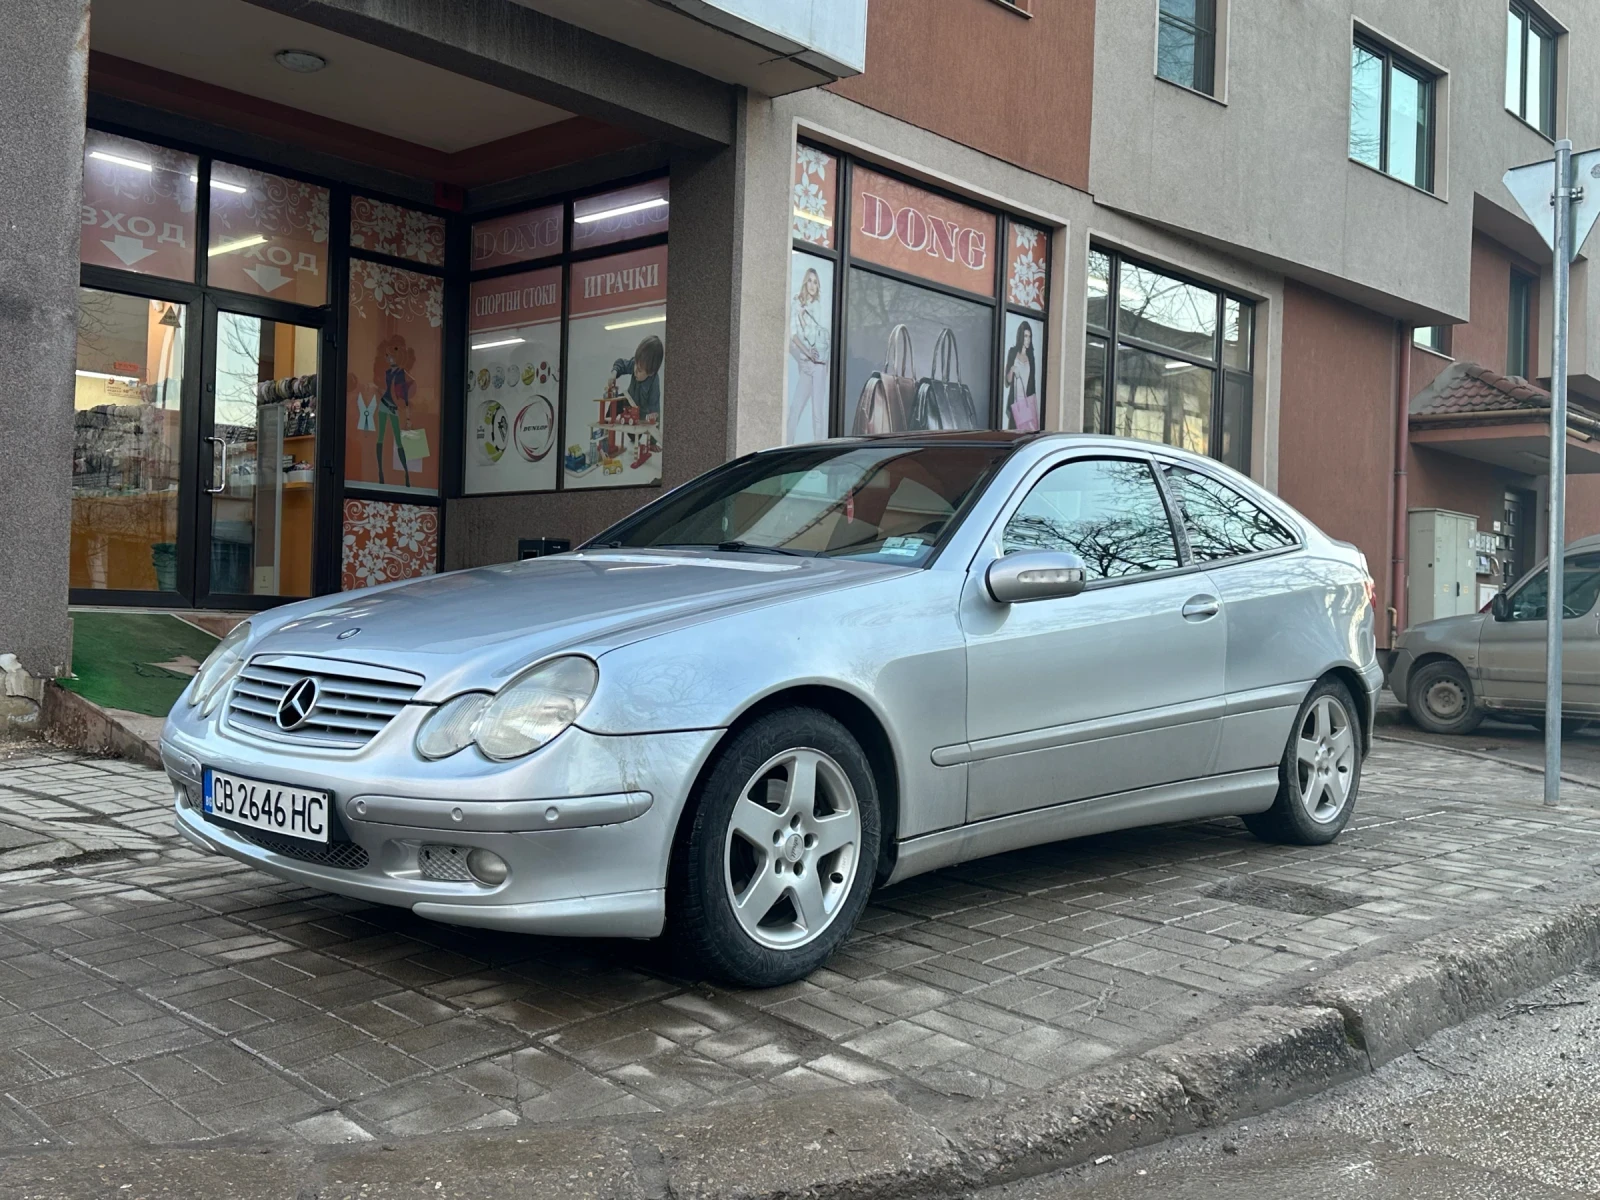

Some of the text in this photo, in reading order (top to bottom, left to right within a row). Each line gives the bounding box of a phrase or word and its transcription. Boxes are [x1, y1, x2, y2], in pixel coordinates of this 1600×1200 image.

[475, 216, 560, 261] DONG
[860, 192, 987, 270] DONG
[475, 283, 557, 317] СПОРТНИ СТОКИ
[583, 264, 659, 299] ИГРАЧКИ
[523, 424, 548, 432] DUNLOP
[214, 777, 323, 835] CB 2646 HC
